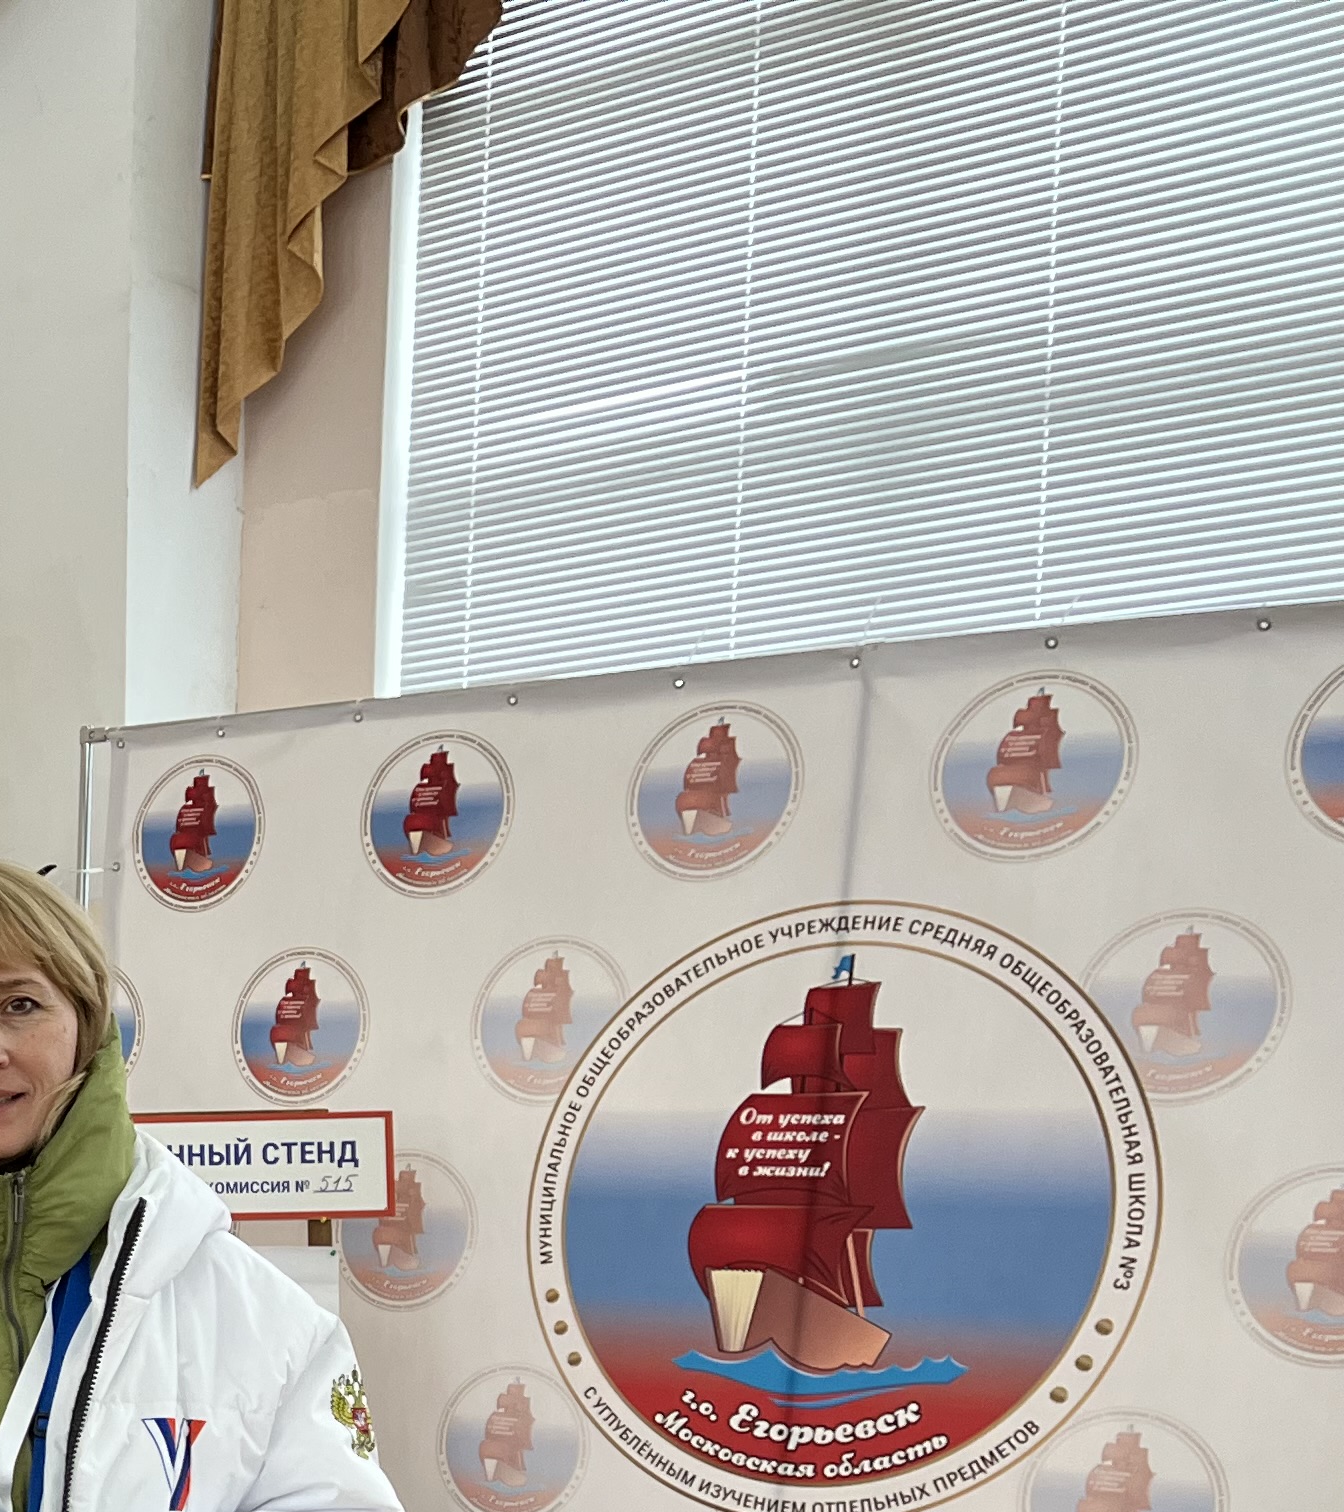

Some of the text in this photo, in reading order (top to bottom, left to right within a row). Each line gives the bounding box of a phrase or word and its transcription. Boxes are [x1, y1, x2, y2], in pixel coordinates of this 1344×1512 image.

[538, 1100, 583, 1265] МУНИЦИПАЛЬНОЕ
[575, 933, 766, 1099] ОБЩЕОБРАЗОВАТЕЛЬНОЕ
[768, 914, 904, 944] УЧРЕЖДЕНИЕ
[908, 919, 999, 961] СРЕДНЯЯ
[999, 952, 1144, 1166] ОБЩЕОБРАЗОВАТЕЛЬНАЯ
[1122, 1172, 1146, 1250] ШКОЛА
[739, 1106, 846, 1128] От успеха
[751, 1130, 763, 1142] в
[766, 1130, 830, 1143] школе
[262, 1140, 359, 1168] СТЕНД
[726, 1148, 812, 1163] к успеху
[738, 1161, 831, 1177] в жизни!
[295, 1180, 310, 1193] №
[319, 1174, 359, 1192] 515
[681, 1388, 922, 1451] г.о. Егорьевск
[583, 1386, 597, 1400] С
[592, 1393, 697, 1488] УГЛУБЛЁННЫМ
[932, 1419, 1041, 1494] ПРЕДМЕТОВ
[653, 1409, 950, 1479] Московская область
